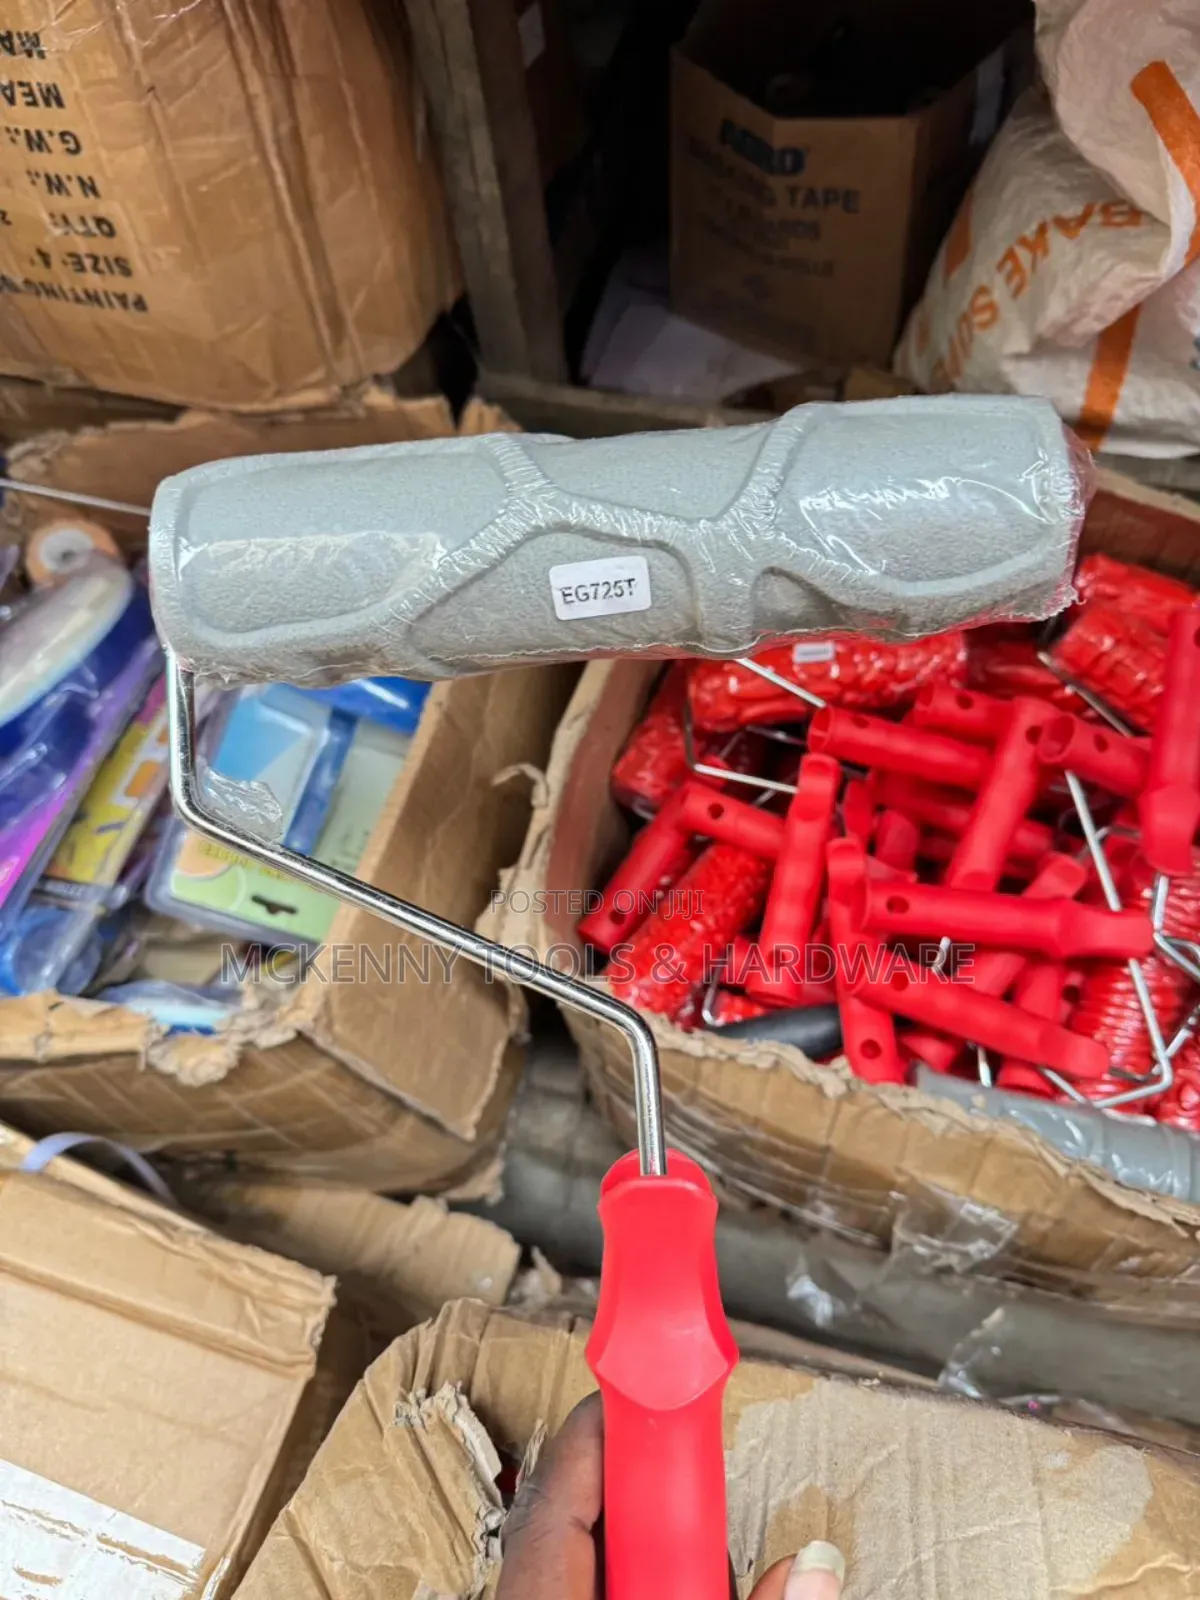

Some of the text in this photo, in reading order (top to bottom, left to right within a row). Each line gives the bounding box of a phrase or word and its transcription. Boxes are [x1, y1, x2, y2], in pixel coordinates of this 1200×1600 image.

[786, 184, 862, 215] TAPE
[996, 200, 1143, 300] BAKE
[559, 577, 636, 605] EG725T
